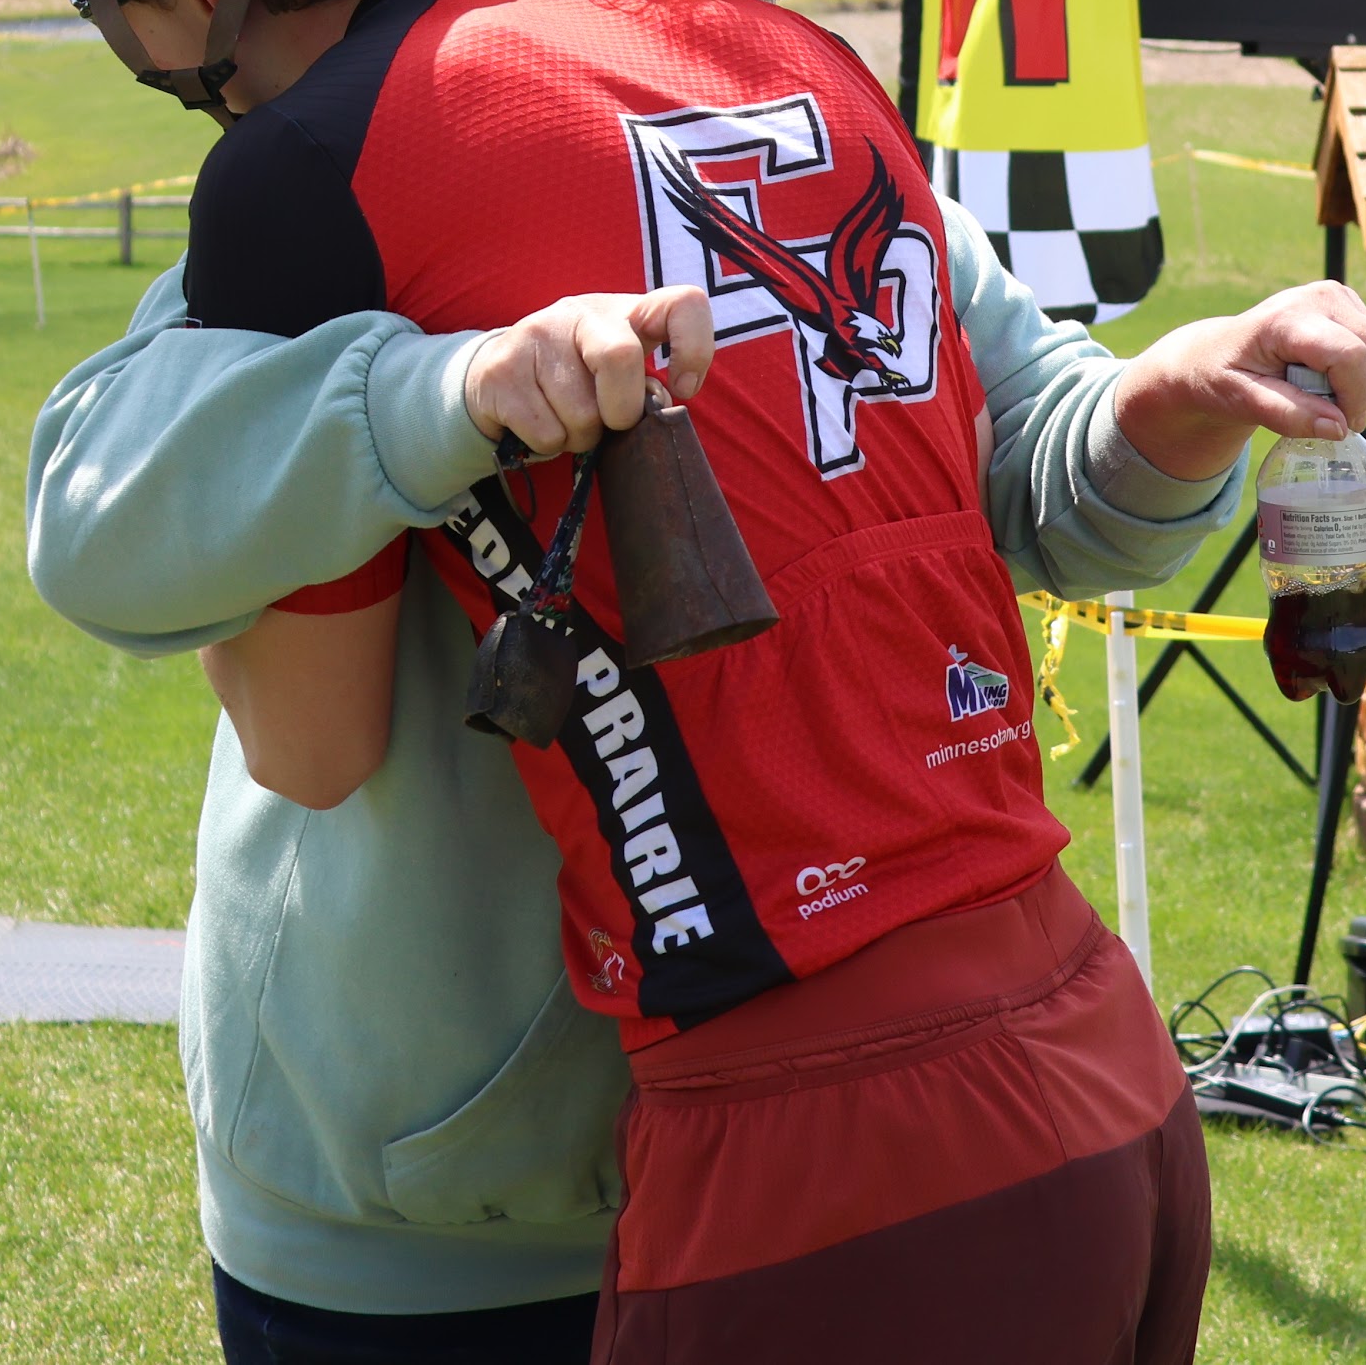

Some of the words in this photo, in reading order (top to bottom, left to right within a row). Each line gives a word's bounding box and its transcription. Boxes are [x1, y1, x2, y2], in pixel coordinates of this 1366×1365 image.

[1282, 512, 1310, 523] Nutrition
[1310, 514, 1330, 523] Facts
[576, 646, 715, 955] PRAIRIE
[797, 882, 869, 920] podium
